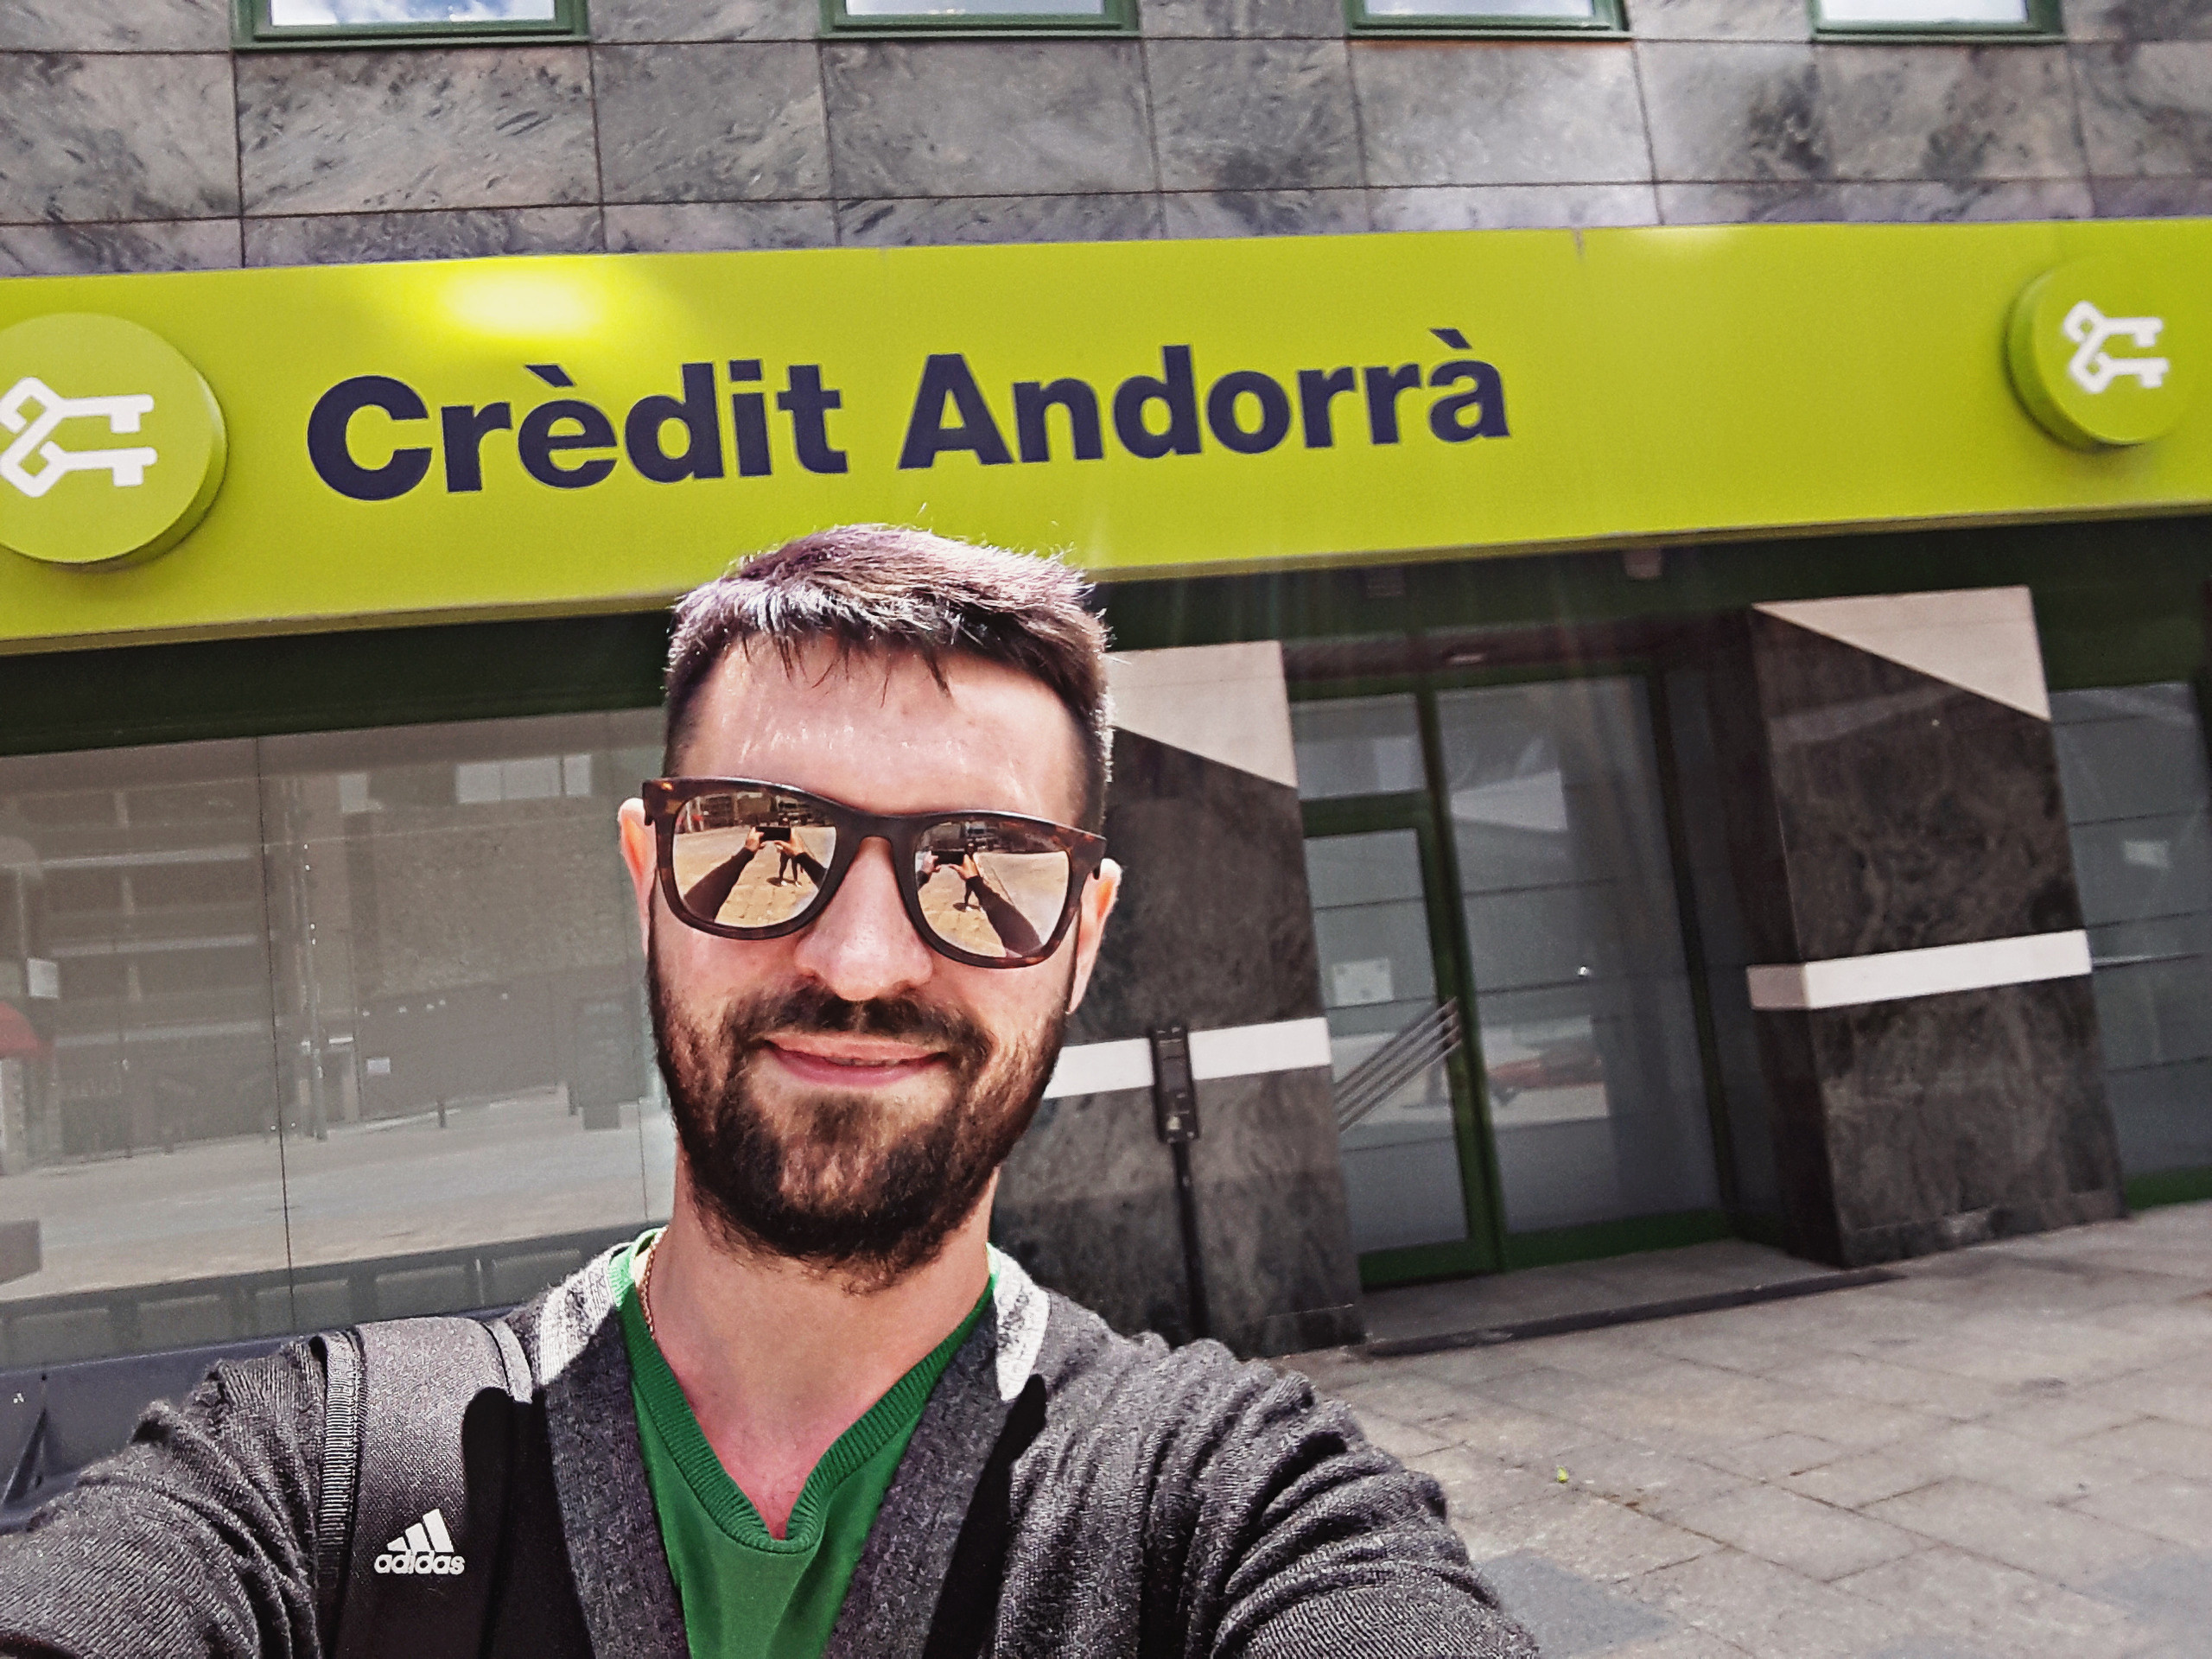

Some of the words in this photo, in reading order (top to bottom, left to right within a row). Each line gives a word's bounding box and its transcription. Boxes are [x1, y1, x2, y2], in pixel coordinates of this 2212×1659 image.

[308, 359, 848, 500] Crèdit
[899, 329, 1510, 469] Andorrà
[374, 1550, 465, 1575] adidas
